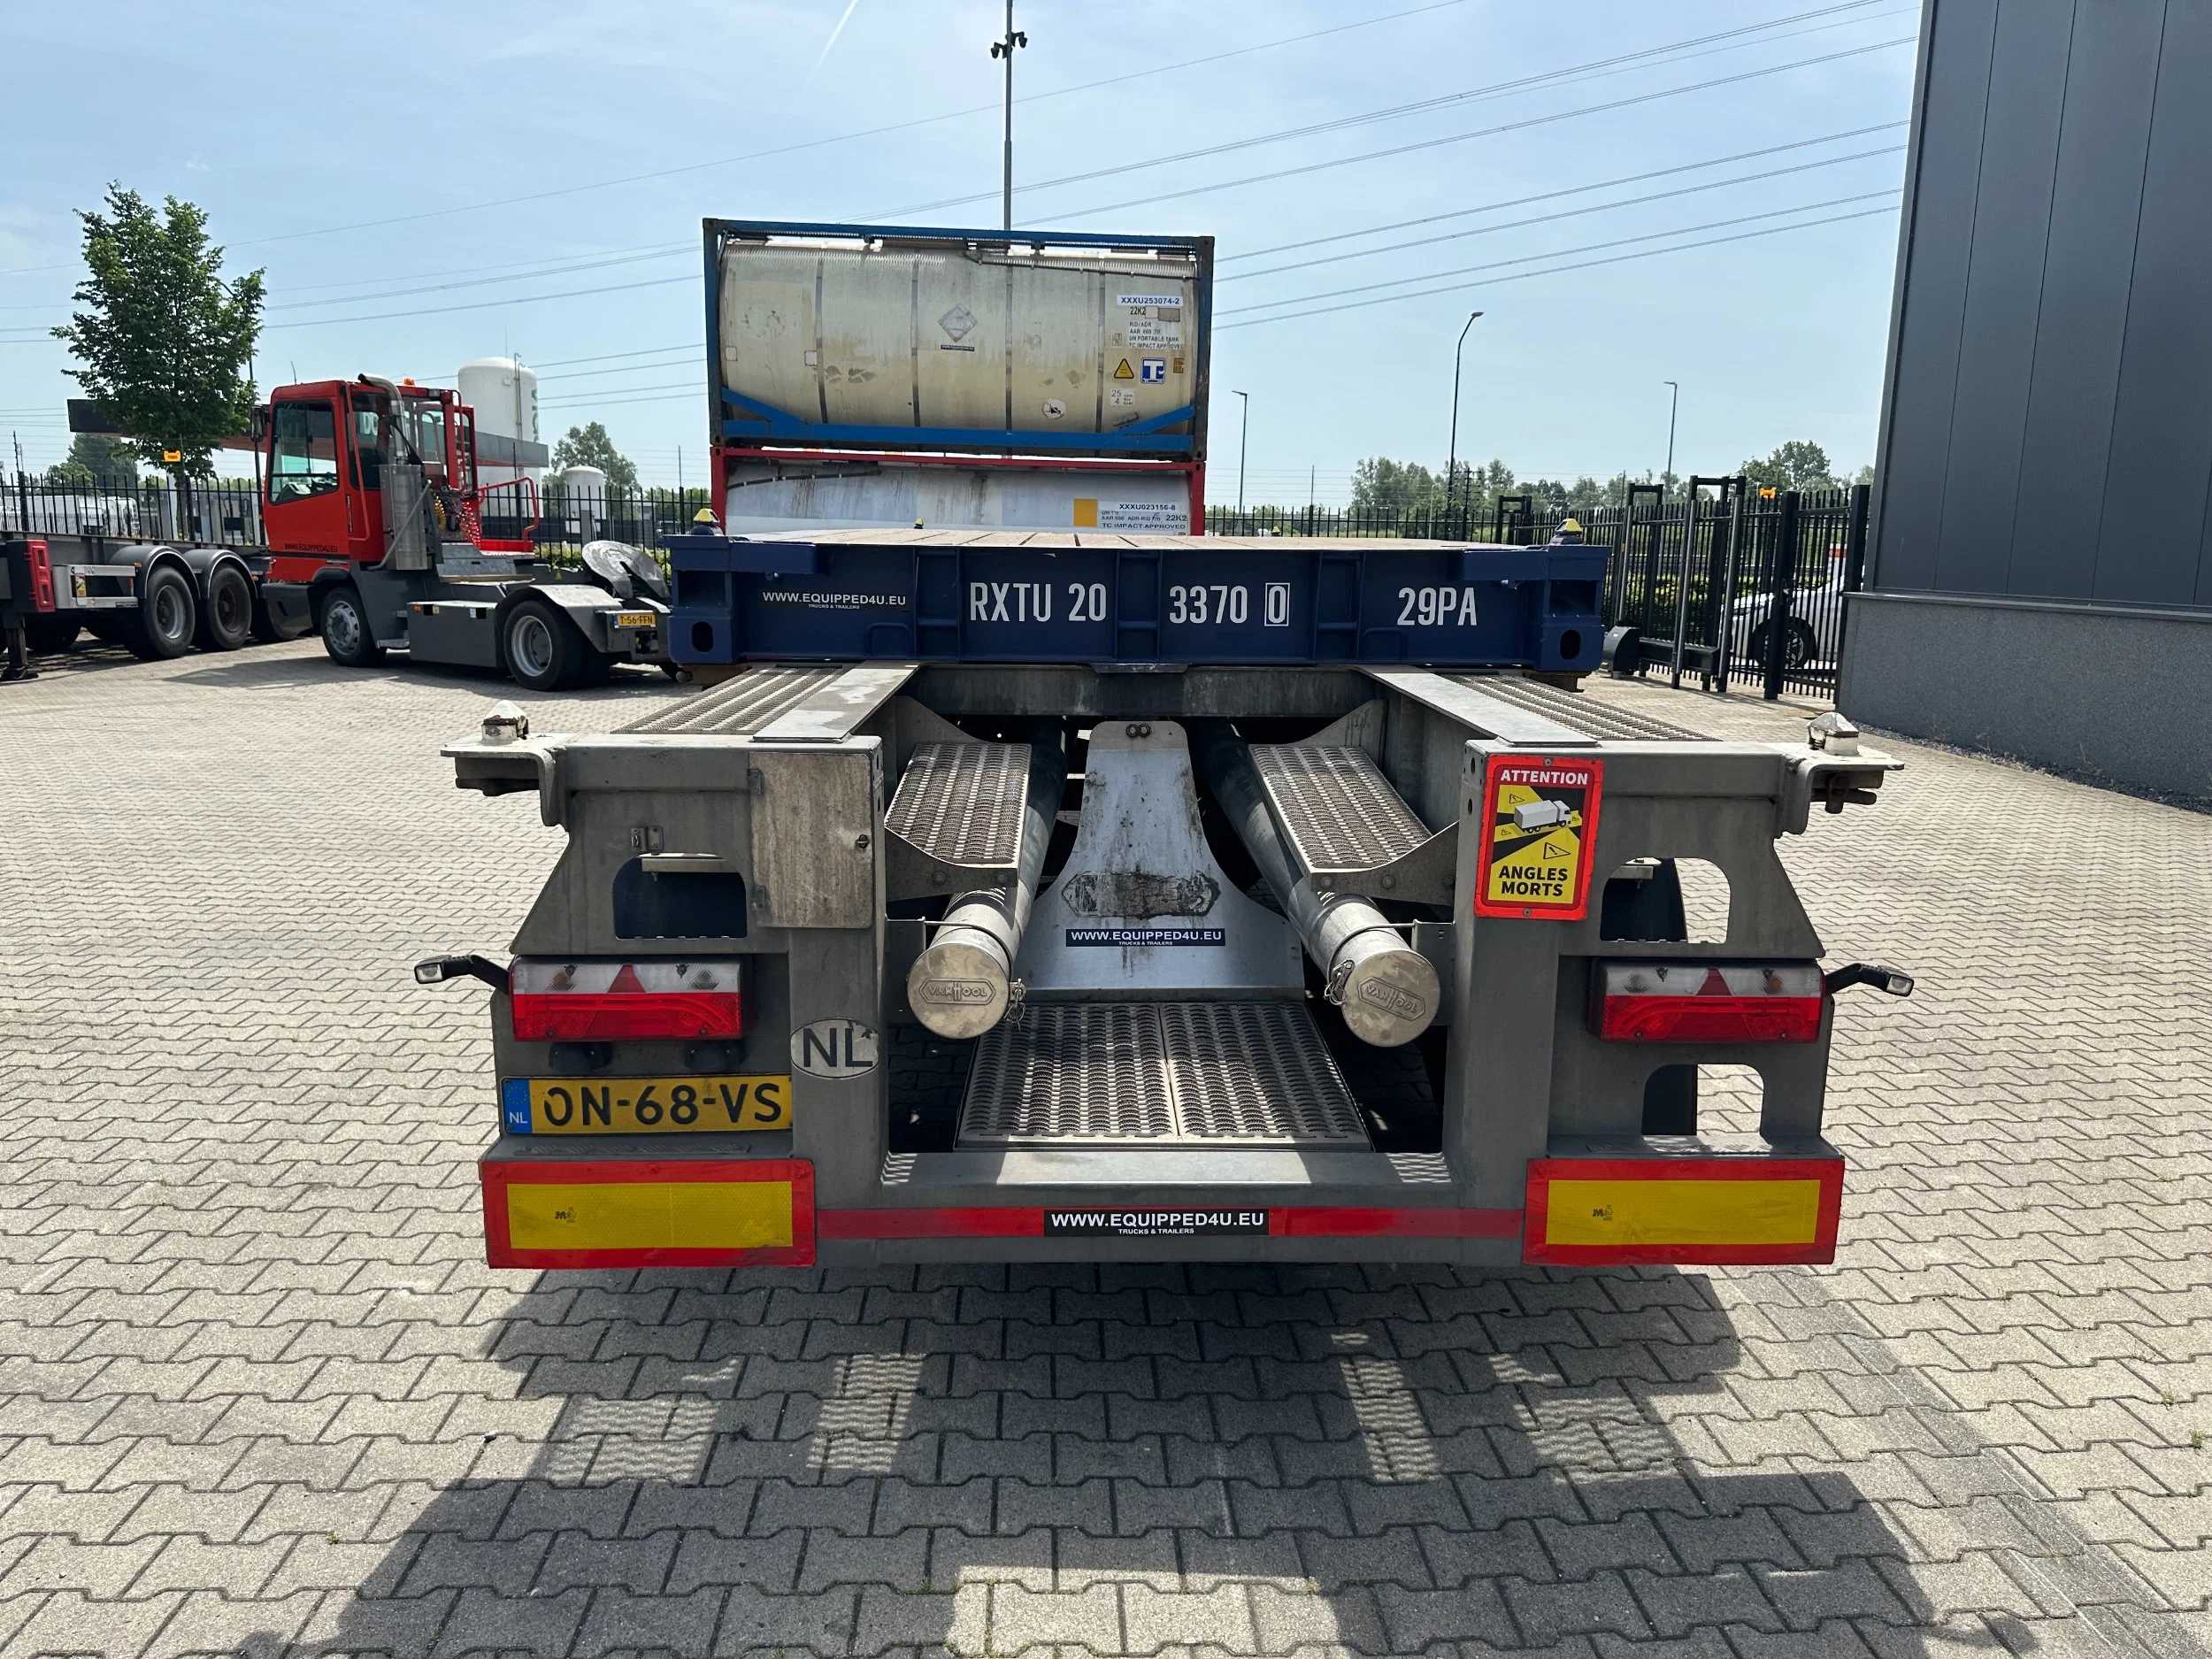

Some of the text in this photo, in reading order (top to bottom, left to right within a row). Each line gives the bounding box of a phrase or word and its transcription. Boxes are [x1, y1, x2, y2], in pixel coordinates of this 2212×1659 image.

[1129, 306, 1147, 316] 22K2
[763, 592, 906, 605] WWW.EQUIPPED4U.EU
[970, 582, 1478, 626] RXTU 20 3370 0 29PA
[619, 615, 653, 625] T-56-FFN
[1500, 769, 1589, 785] ATTENTION
[1498, 865, 1569, 882] ANGLES
[1501, 880, 1564, 897] MORTS
[1071, 931, 1222, 941] WWW.EQUIPPED4U.EU
[802, 1027, 874, 1068] NL
[509, 1082, 781, 1126] NL ON-68-VS
[1051, 1213, 1264, 1227] WWW.EQUIPPED4U.EU
